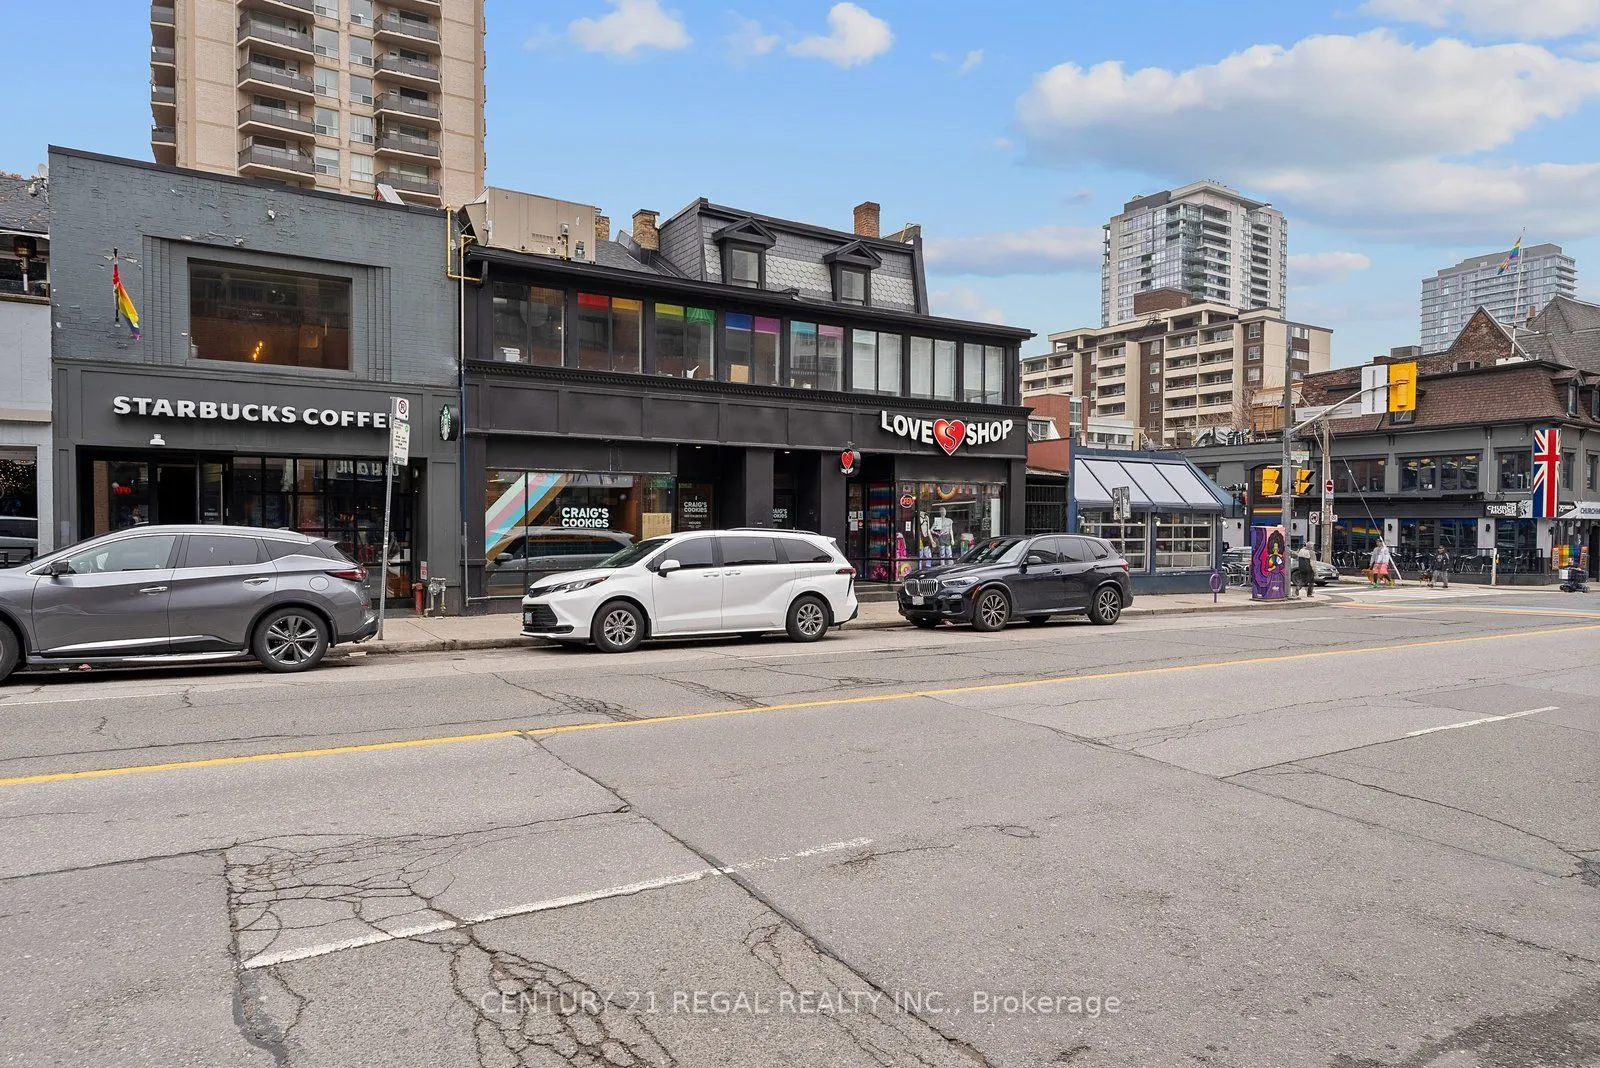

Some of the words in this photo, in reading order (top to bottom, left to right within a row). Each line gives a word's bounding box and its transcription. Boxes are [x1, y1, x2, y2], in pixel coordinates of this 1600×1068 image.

[112, 395, 298, 423] STARBUCKS
[302, 408, 392, 429] COFFE
[881, 410, 933, 445] LOVE
[965, 419, 1014, 446] SHOP
[561, 507, 610, 519] CRAIG'S
